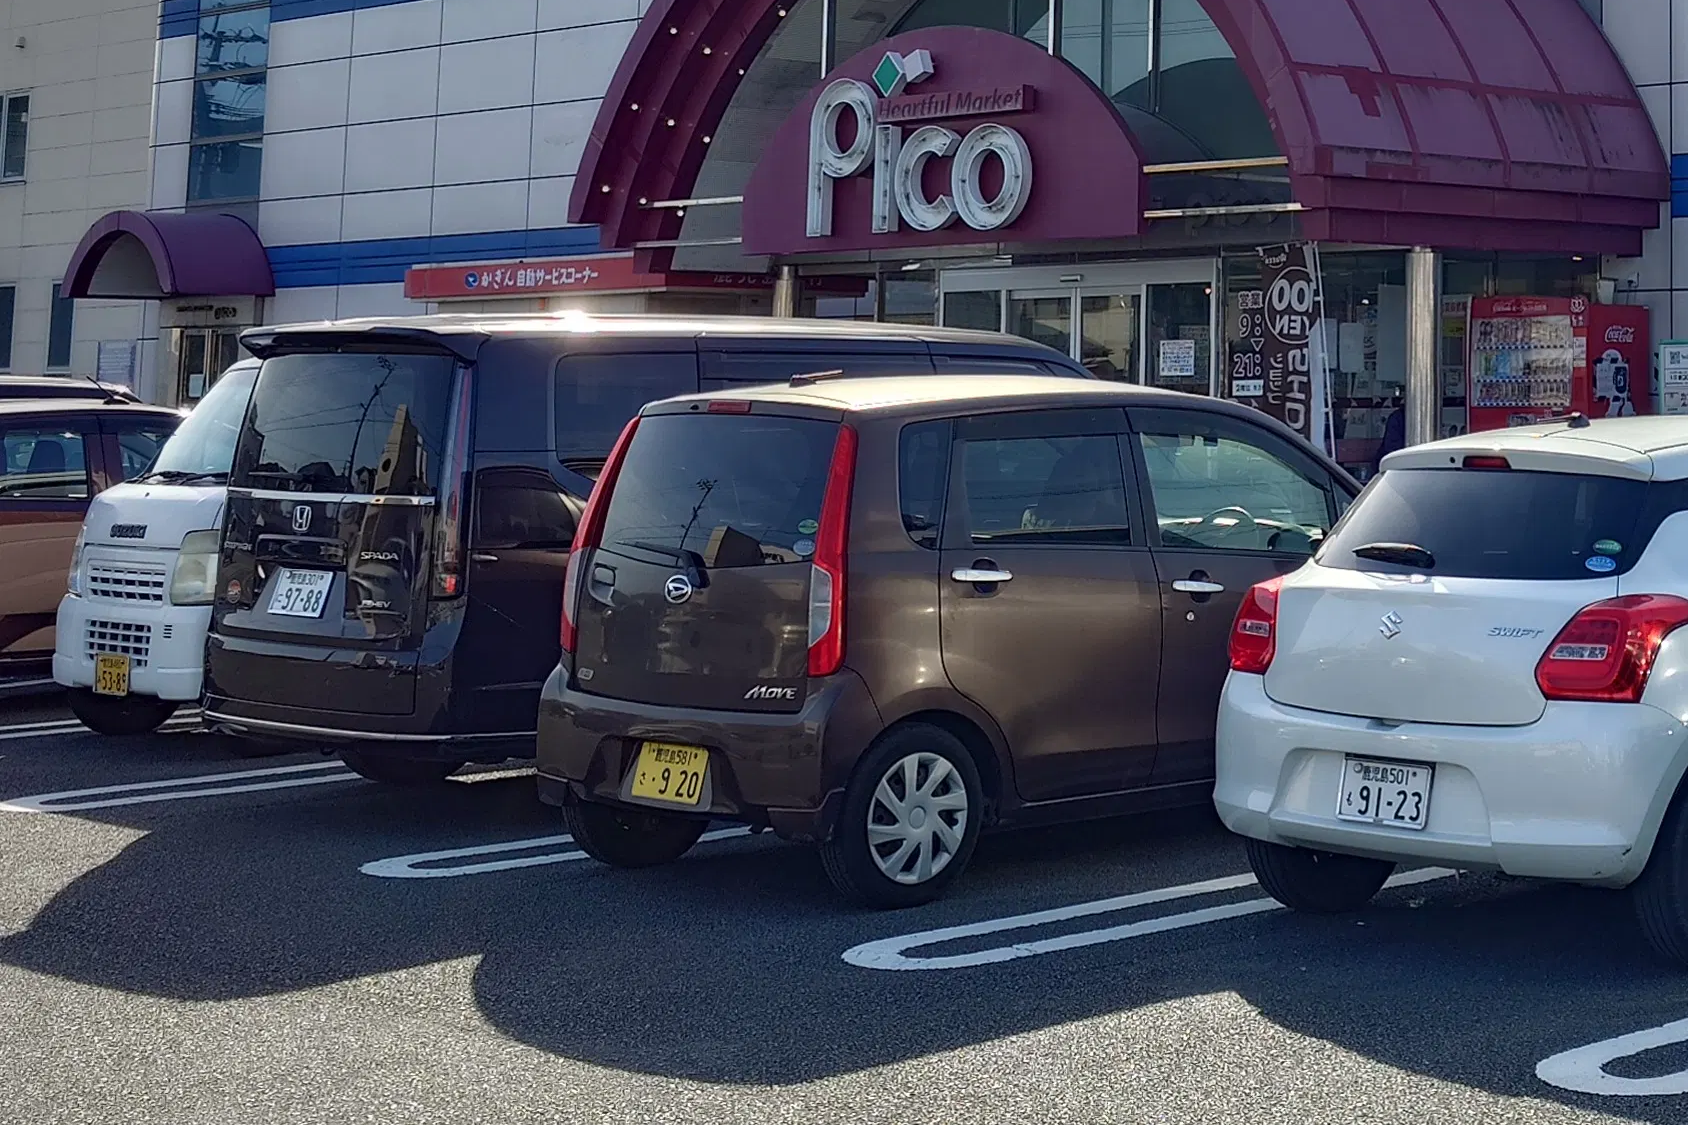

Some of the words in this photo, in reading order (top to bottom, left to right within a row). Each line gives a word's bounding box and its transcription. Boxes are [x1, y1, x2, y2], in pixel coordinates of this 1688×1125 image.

[877, 93, 950, 121] Heartful
[956, 87, 1023, 113] Market
[481, 269, 514, 289] かぎん
[516, 266, 599, 287] 自動サービスコーナー
[1238, 290, 1263, 310] 営業
[360, 551, 400, 561] SPADA
[283, 587, 323, 613] 97-88
[1487, 627, 1545, 639] SWIFT
[744, 685, 798, 700] MOVE
[1357, 785, 1423, 822] 91-23
